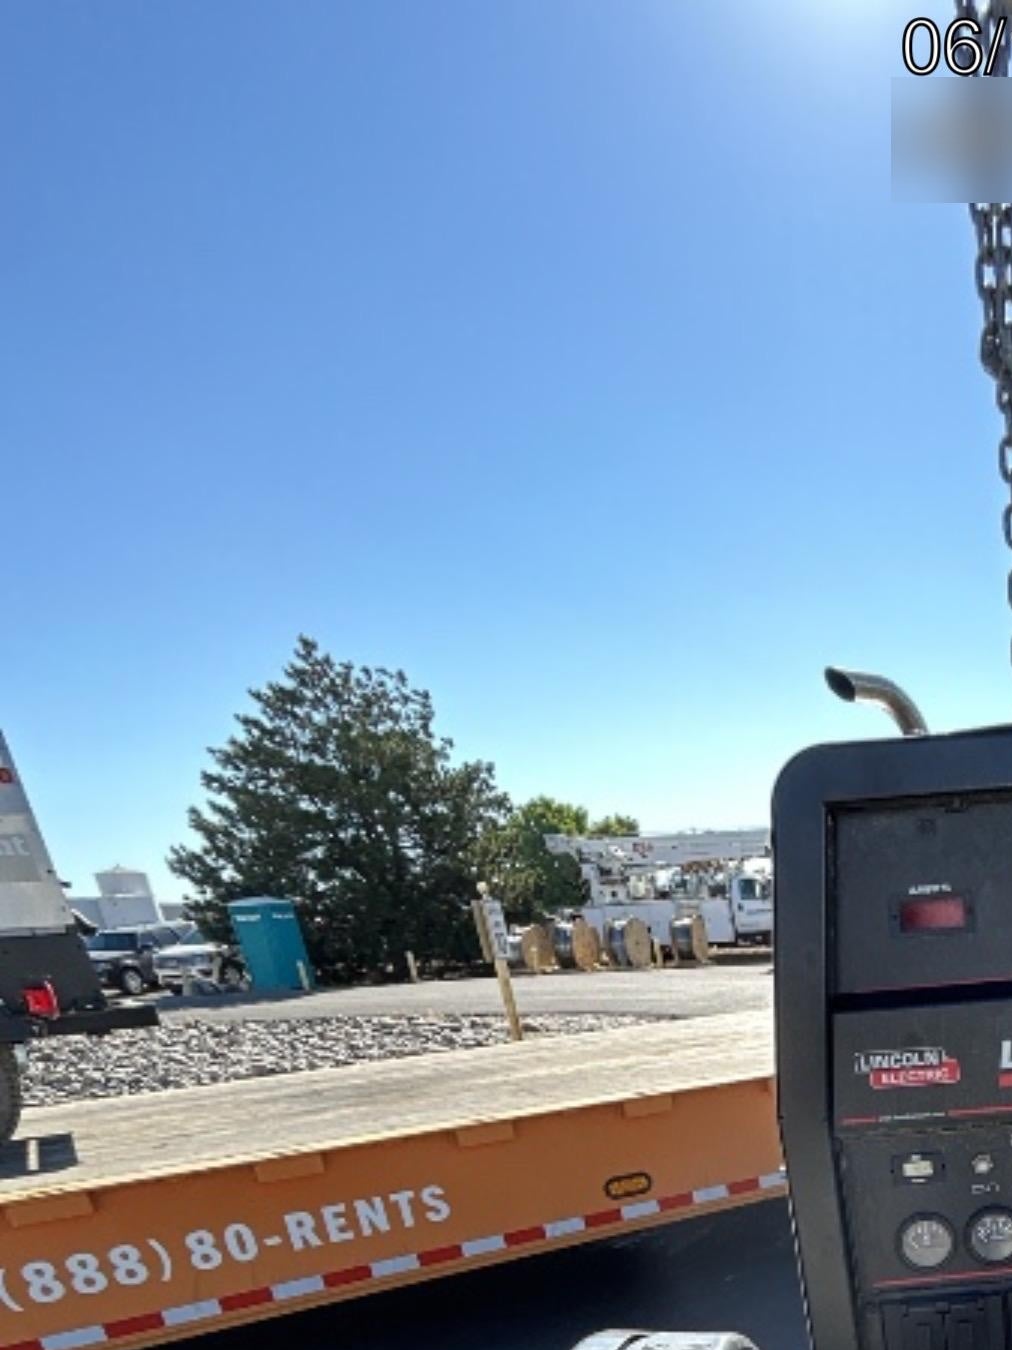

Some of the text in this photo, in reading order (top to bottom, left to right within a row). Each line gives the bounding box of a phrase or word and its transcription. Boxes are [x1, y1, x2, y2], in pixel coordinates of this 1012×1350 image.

[860, 1050, 940, 1073] LINCOLN
[0, 1184, 451, 1312] (888) 80-RENTS
